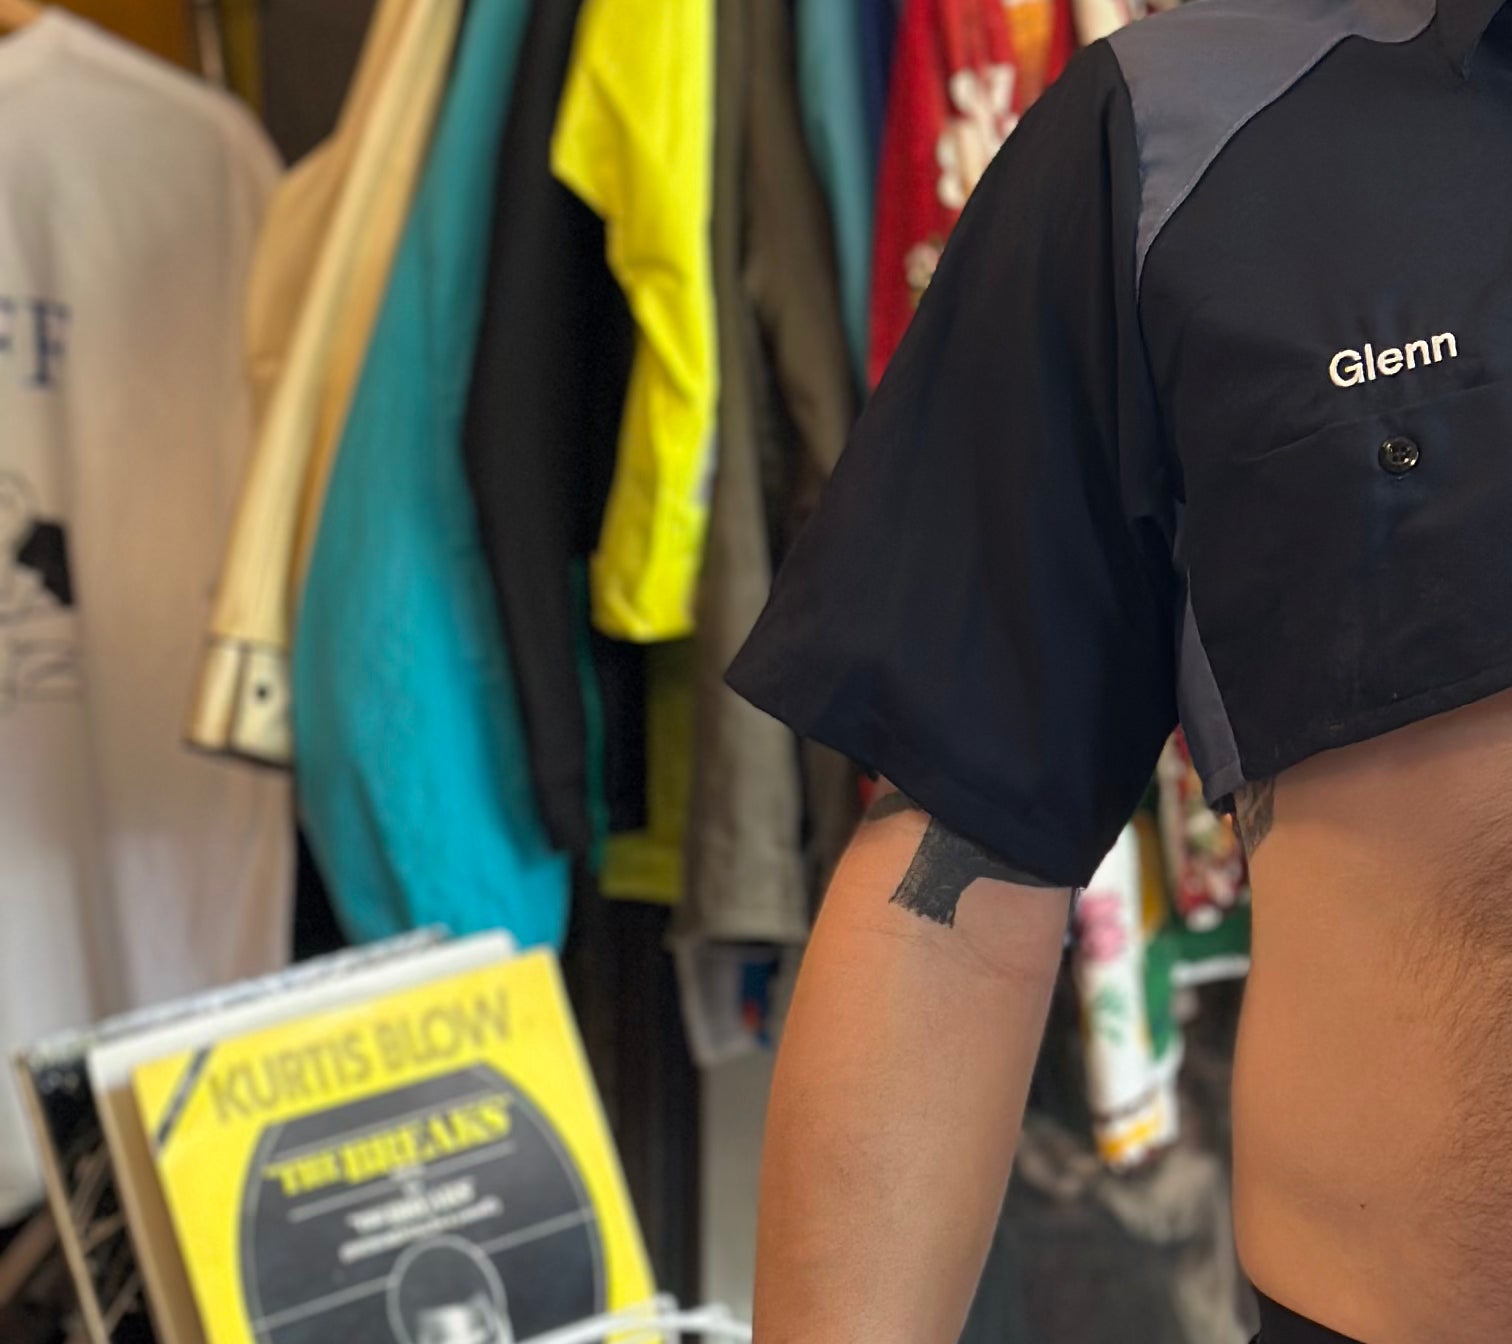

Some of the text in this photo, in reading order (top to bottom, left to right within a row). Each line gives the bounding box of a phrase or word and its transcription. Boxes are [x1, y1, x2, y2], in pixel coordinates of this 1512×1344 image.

[1329, 332, 1458, 387] Glenn
[207, 985, 513, 1120] KURTIS BLOW
